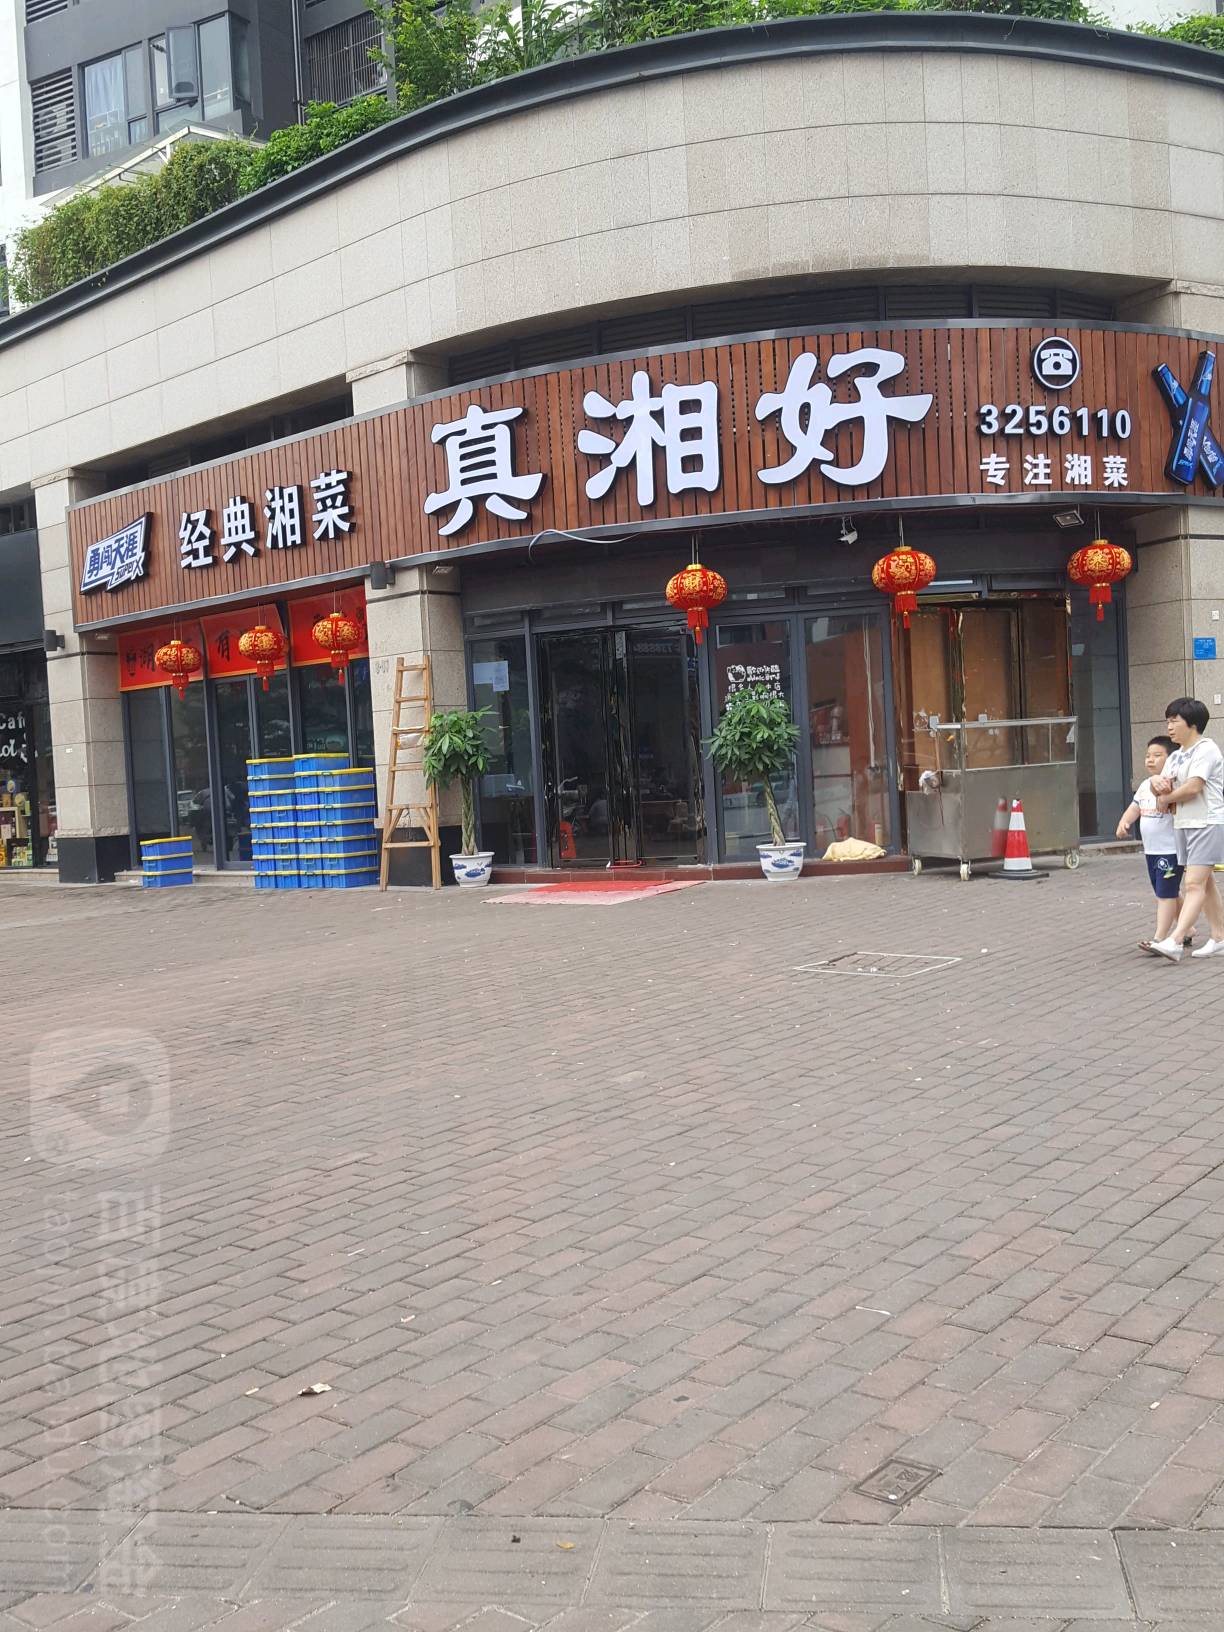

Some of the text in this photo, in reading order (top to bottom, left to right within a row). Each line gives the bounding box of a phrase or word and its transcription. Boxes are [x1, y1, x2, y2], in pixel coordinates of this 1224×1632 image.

[423, 347, 934, 536] 真湘好
[979, 404, 1132, 439] 3256110
[979, 453, 1129, 487] 专注湘菜
[179, 469, 351, 569] 经典湘菜
[87, 530, 139, 579] 勇闯天涯
